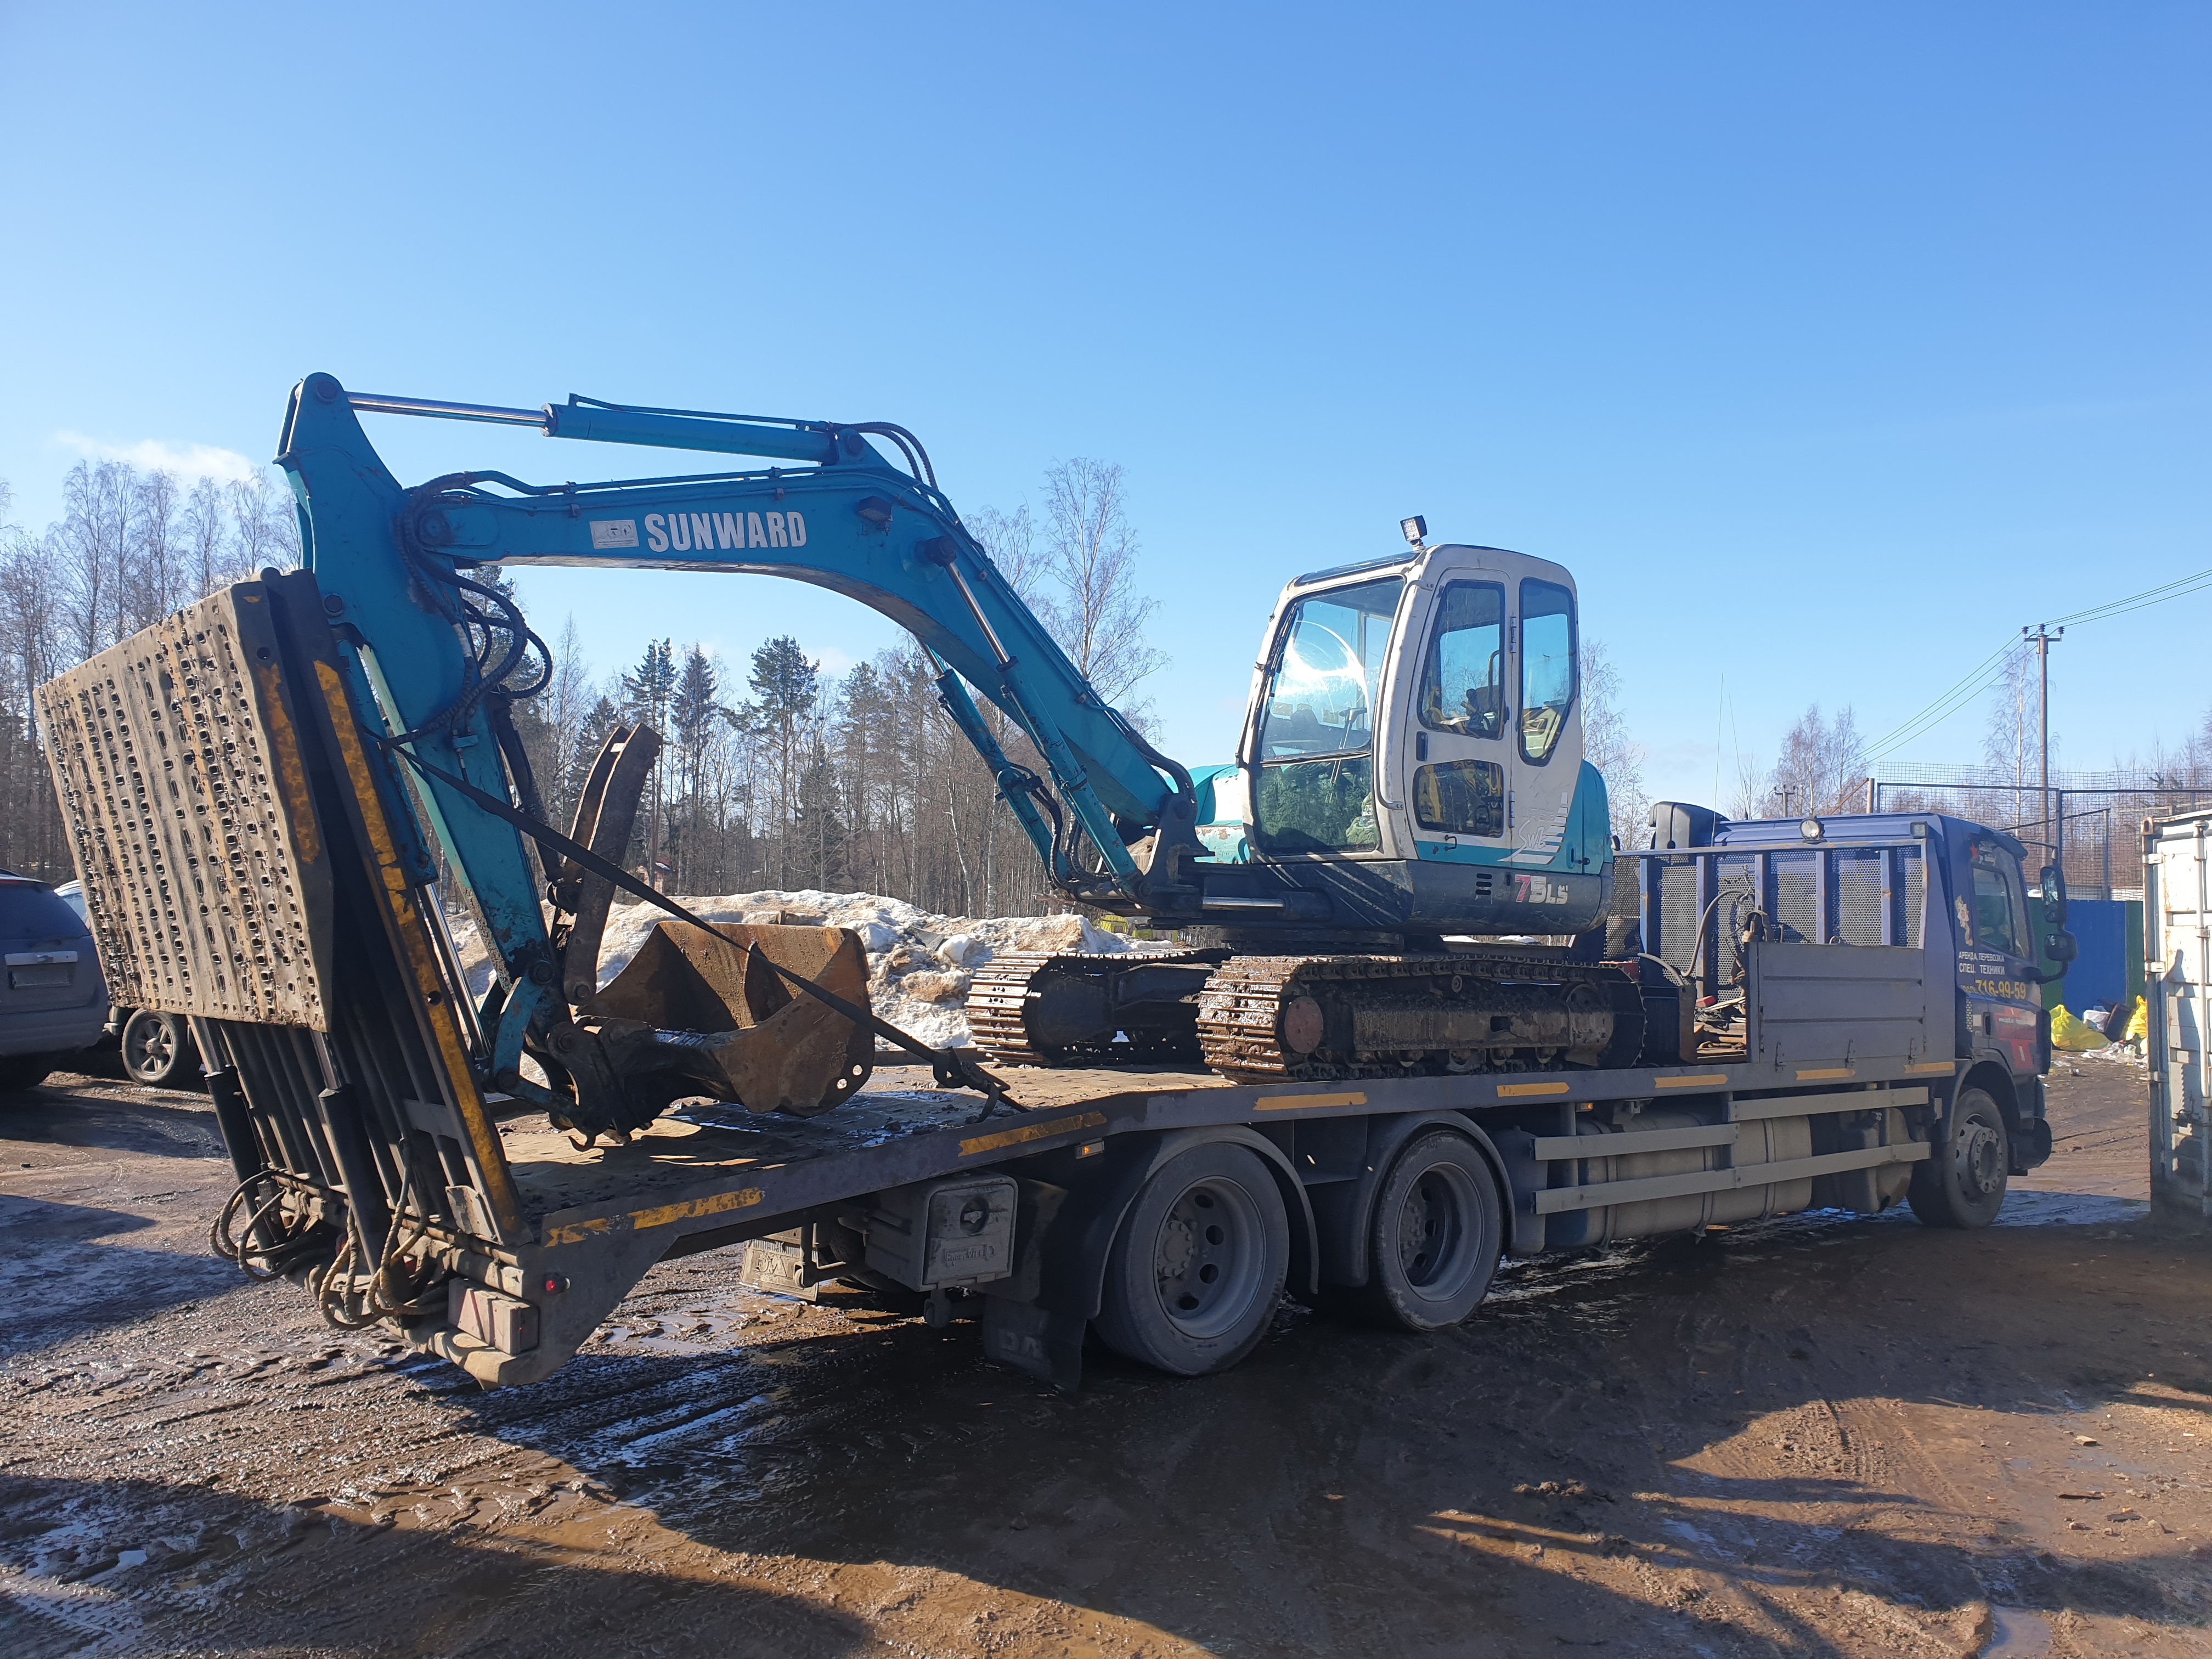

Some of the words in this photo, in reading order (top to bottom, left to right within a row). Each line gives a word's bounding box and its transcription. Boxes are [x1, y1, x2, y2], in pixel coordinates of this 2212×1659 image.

[645, 511, 807, 552] SUNWARD
[1978, 953, 2005, 962] ПЕРЕВОЗКА
[1979, 964, 2005, 975] ТЕХНИКИ
[1975, 979, 2026, 1000] 716-99-59
